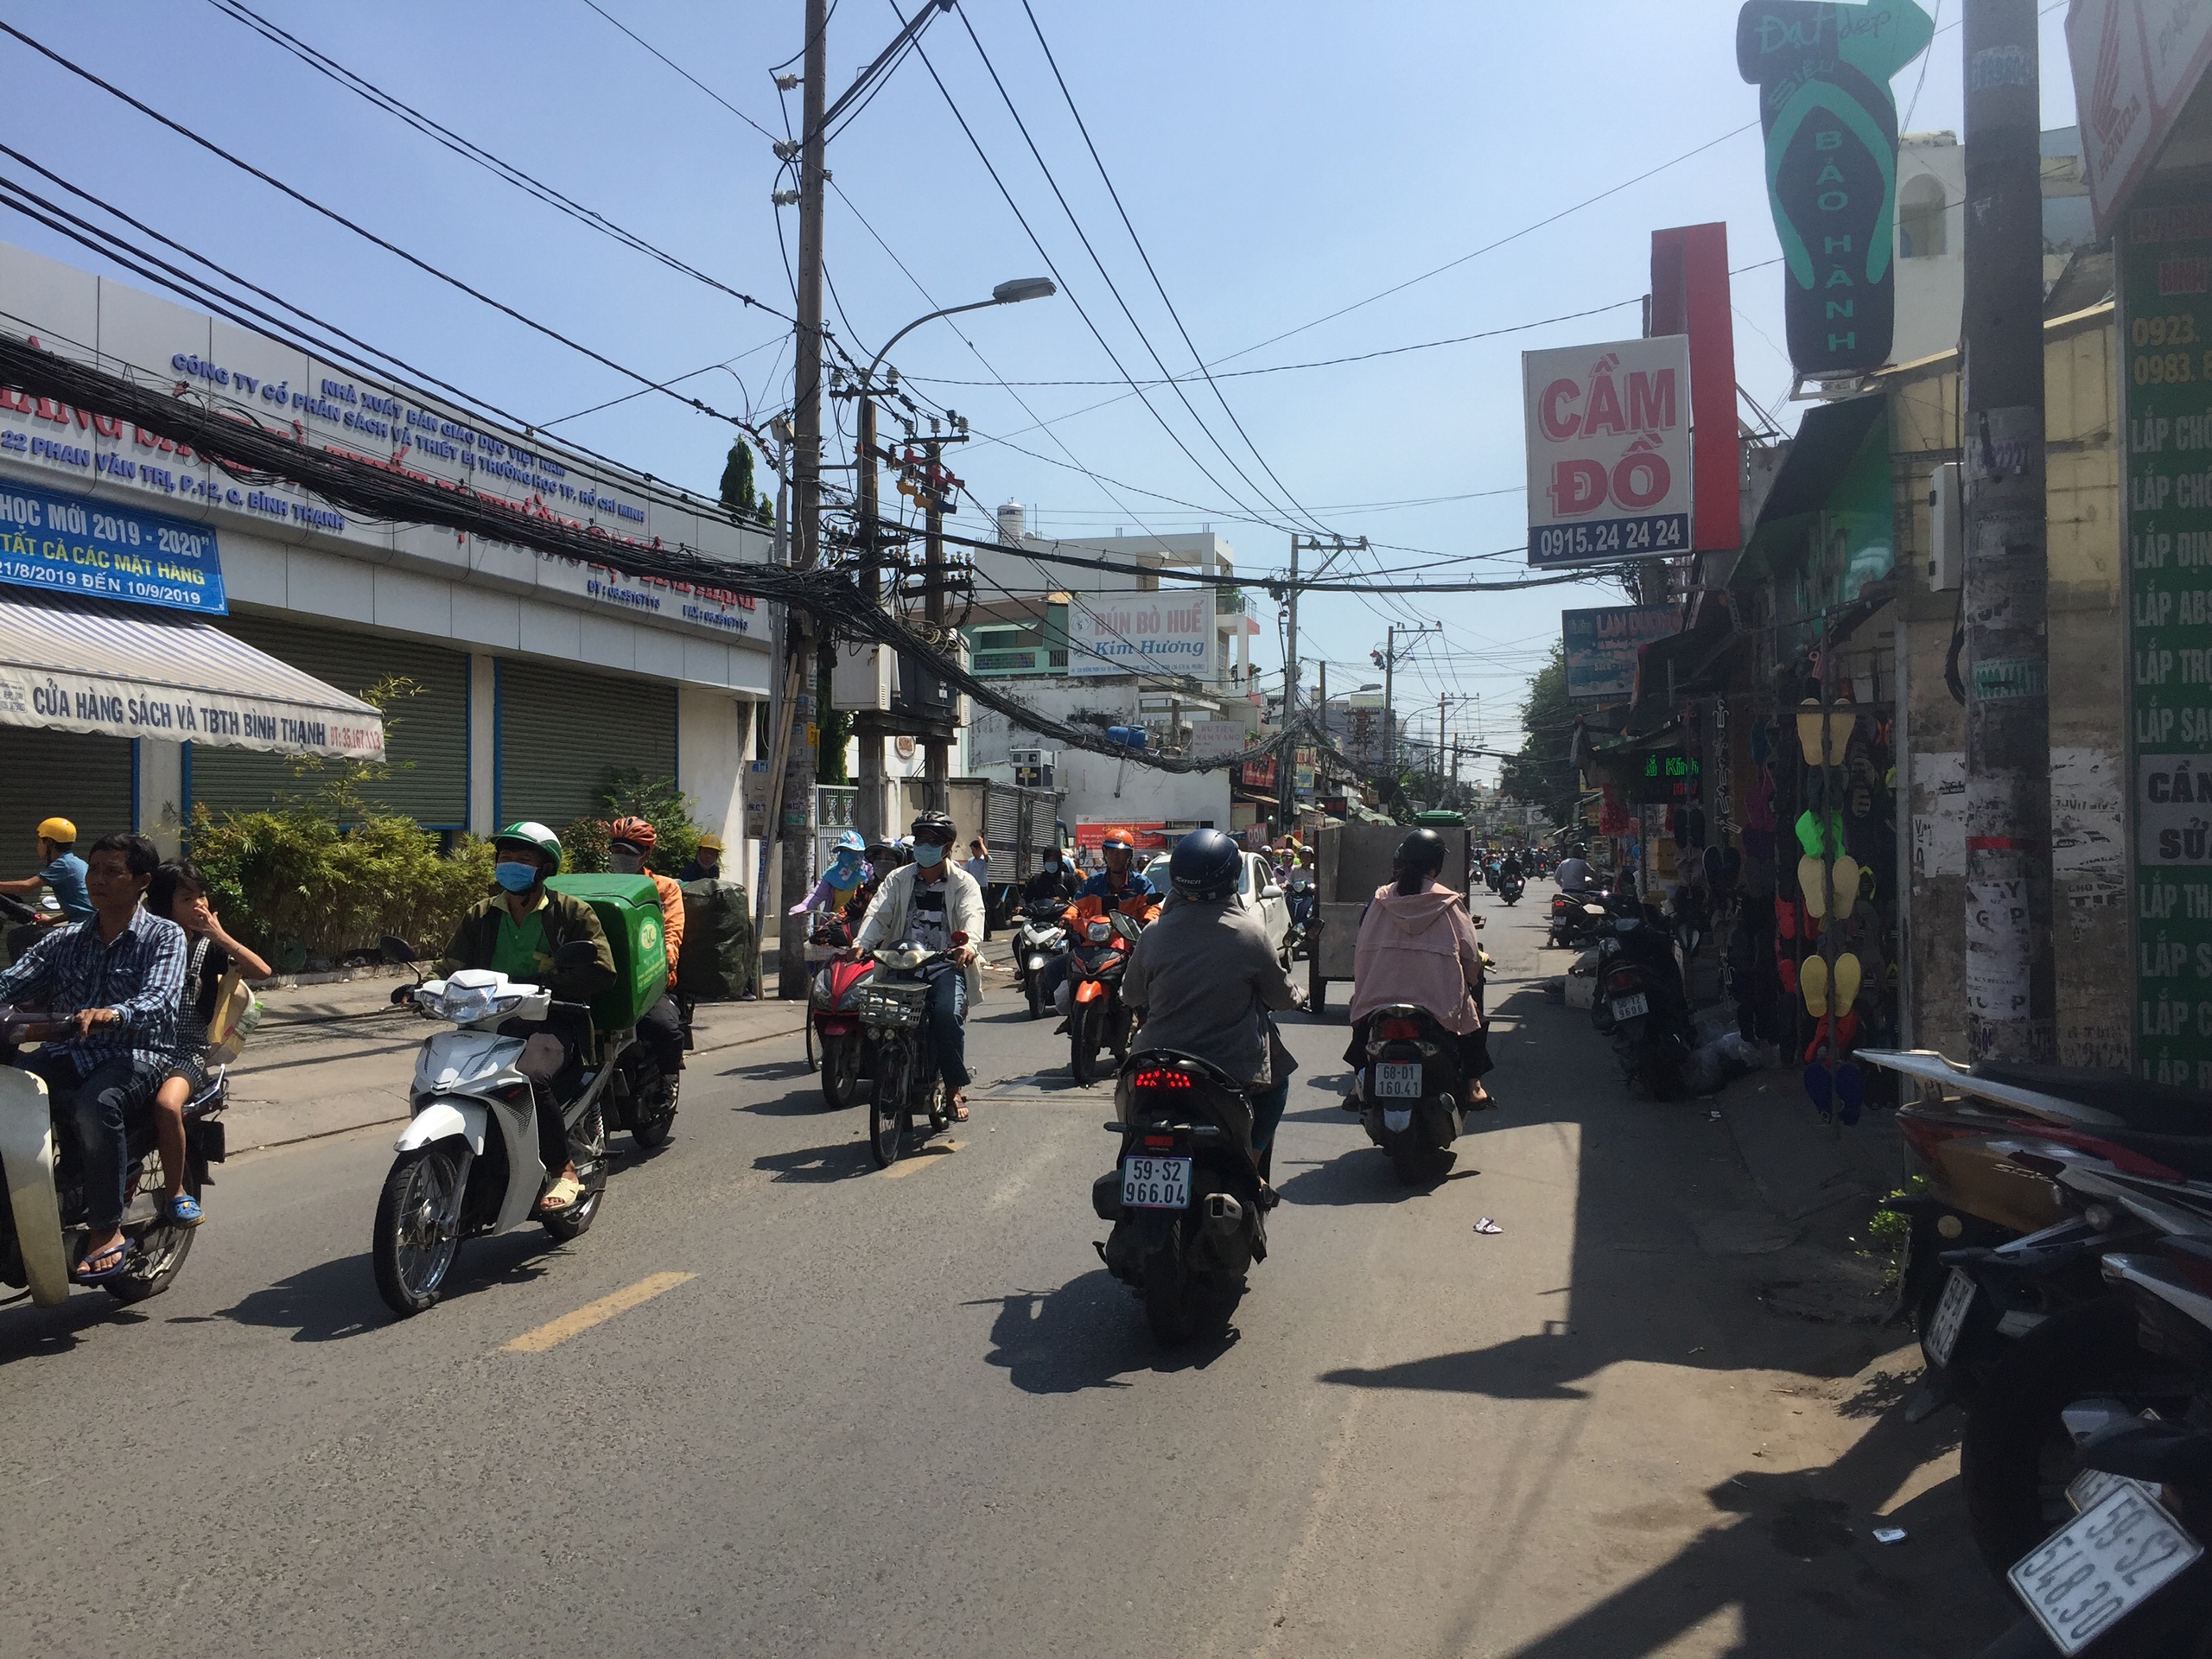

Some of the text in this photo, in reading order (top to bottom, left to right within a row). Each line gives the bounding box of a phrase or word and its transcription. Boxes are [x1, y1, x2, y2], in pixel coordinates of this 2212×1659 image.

[322, 378, 357, 404] NHÀ
[361, 392, 404, 419] XUẤT
[407, 409, 438, 431] BẢN
[442, 421, 475, 444] GIÁO
[479, 434, 505, 456] DỤC
[1538, 353, 1676, 442] CẦM
[172, 353, 229, 385] CÔNG
[233, 372, 259, 393] TY
[262, 380, 289, 404] CỔ
[293, 395, 341, 422] PHẦN
[345, 410, 388, 437] SÁCH
[391, 427, 412, 445] VÀ
[416, 435, 460, 460] THIẾT
[461, 450, 476, 470] BỊ
[479, 455, 531, 485] TRƯỜNG
[532, 478, 557, 494] HỌC
[579, 488, 596, 505] HỒ
[598, 496, 616, 513] CHÍ
[617, 504, 645, 523] MINH
[32, 436, 90, 467] PHAN
[96, 452, 137, 479] VĂN
[249, 490, 289, 516] BÌNH
[292, 503, 346, 530] THẠNH
[1547, 433, 1671, 518] ĐỒ
[48, 503, 87, 536] MỚI
[92, 514, 141, 547] 2019
[1626, 521, 1650, 549] 24
[1656, 518, 1680, 546] 24
[0, 530, 206, 585] TẤT CẢ CÁC MẶT HÀNG
[81, 572, 120, 593] ĐẾN
[128, 581, 201, 604] 10/9/2019
[1095, 599, 1205, 636] BÚN BÒ HUẾ
[1096, 640, 1205, 657] Kim Hương
[33, 677, 71, 717] CỬA
[76, 687, 124, 724] HÀNG
[127, 693, 172, 728] SÁCH
[175, 699, 197, 730] VÀ
[200, 707, 239, 735] TBTH
[243, 709, 276, 741] BÌNH
[281, 717, 326, 748] THẠNH
[1125, 1182, 1185, 1205] 966.04
